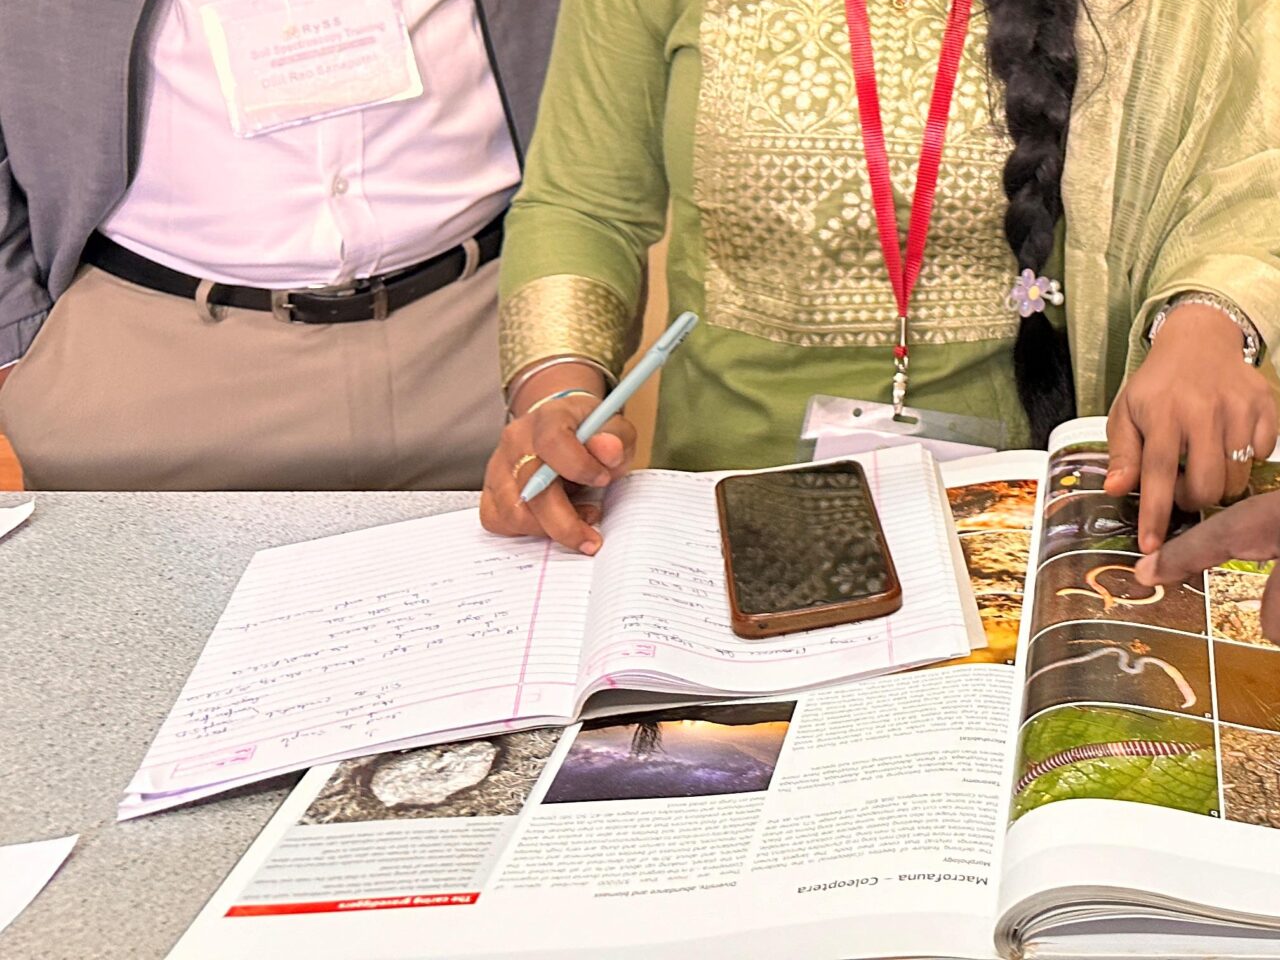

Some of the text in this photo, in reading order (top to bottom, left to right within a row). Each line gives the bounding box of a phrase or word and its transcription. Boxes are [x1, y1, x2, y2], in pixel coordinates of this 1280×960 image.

[797, 876, 878, 894] Coleoptera
[897, 873, 988, 885] Macrofauna
[449, 894, 473, 903] The
